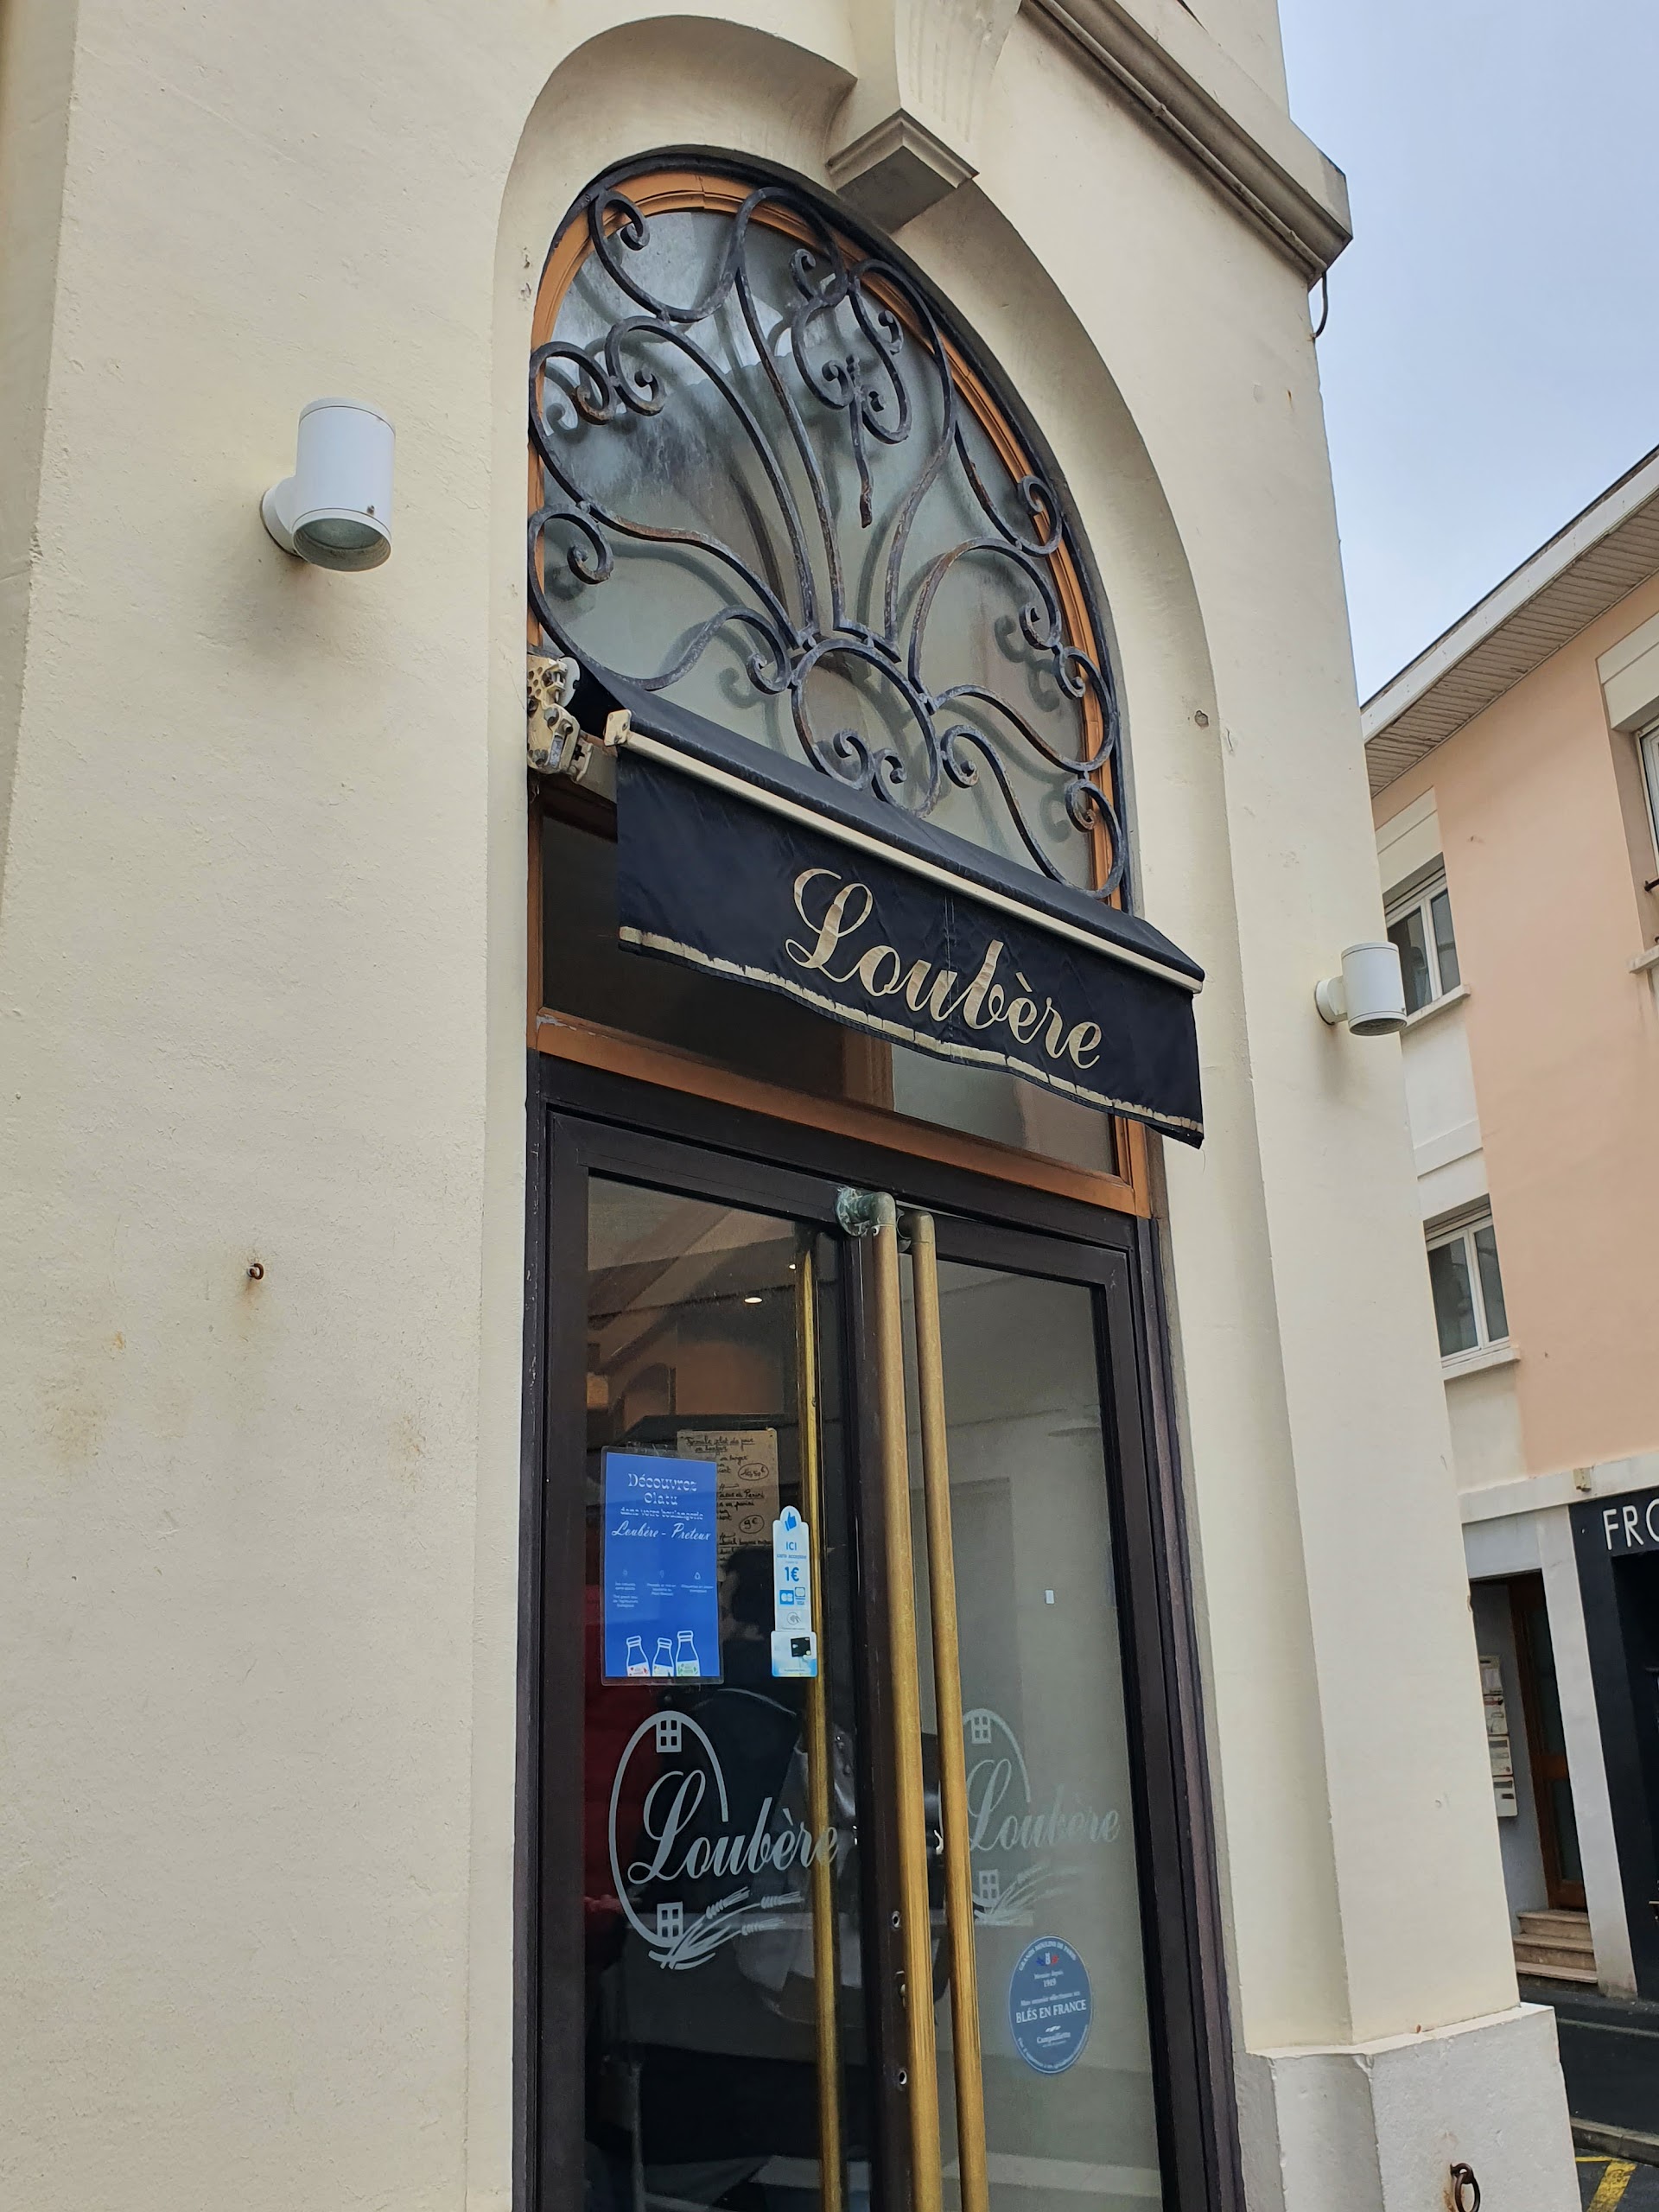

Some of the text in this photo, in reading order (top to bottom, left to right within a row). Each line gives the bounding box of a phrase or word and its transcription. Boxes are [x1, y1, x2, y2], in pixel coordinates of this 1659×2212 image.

[785, 868, 1102, 1070] Loubère
[628, 1473, 697, 1492] Découvrez
[644, 1492, 678, 1506] Olatu
[620, 1507, 704, 1521] dans votre boulangerie
[785, 1541, 798, 1551] ICI
[785, 1566, 800, 1583] 1€
[966, 1758, 1122, 1852] Loubère
[627, 1769, 839, 1885] Loubère
[1016, 1999, 1087, 2024] BLÉS EN FRANCE
